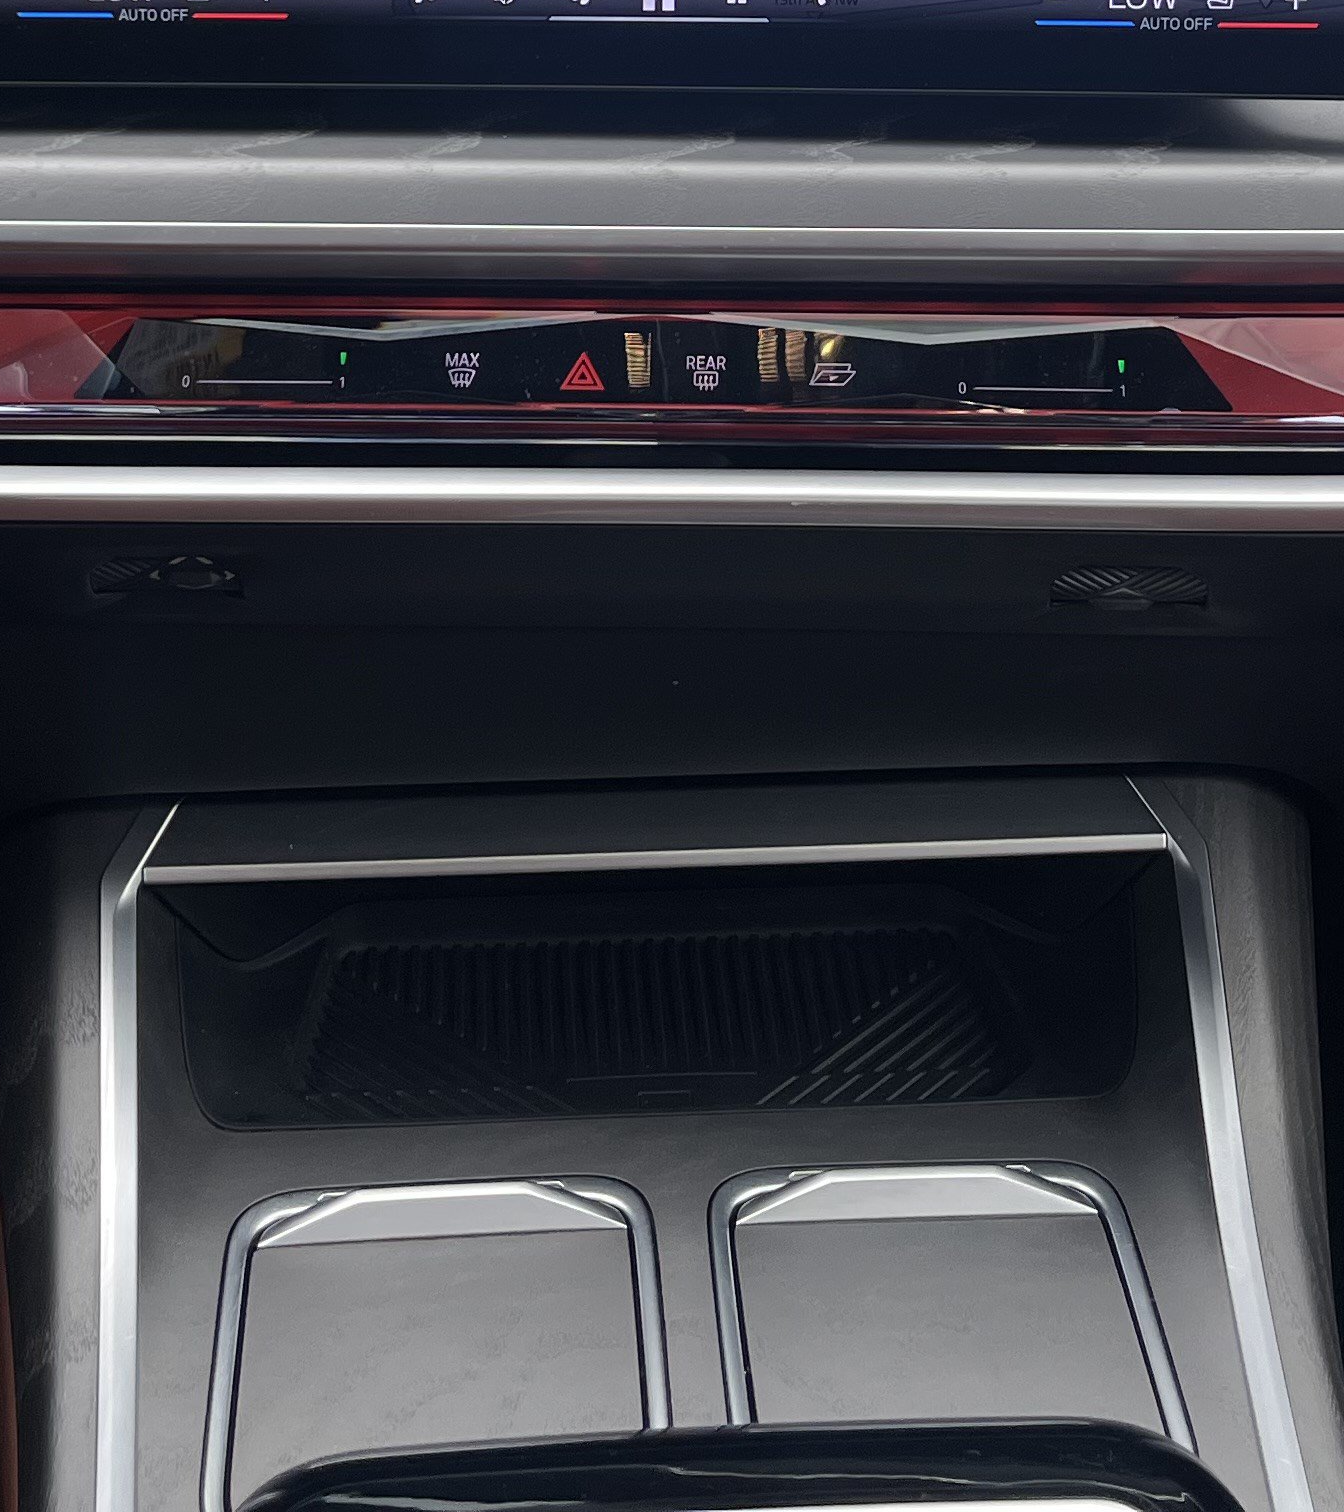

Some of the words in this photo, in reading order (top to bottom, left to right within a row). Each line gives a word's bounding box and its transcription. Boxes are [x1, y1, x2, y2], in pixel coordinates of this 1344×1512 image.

[119, 9, 159, 22] AUTO
[160, 9, 189, 22] OFF
[1140, 17, 1181, 31] AUTO
[1184, 17, 1212, 31] OFF
[445, 352, 480, 368] MAX
[686, 356, 726, 371] REAR
[182, 375, 190, 389] 0
[339, 376, 345, 389] 1
[958, 382, 967, 395] 0
[1120, 384, 1126, 397] 1
